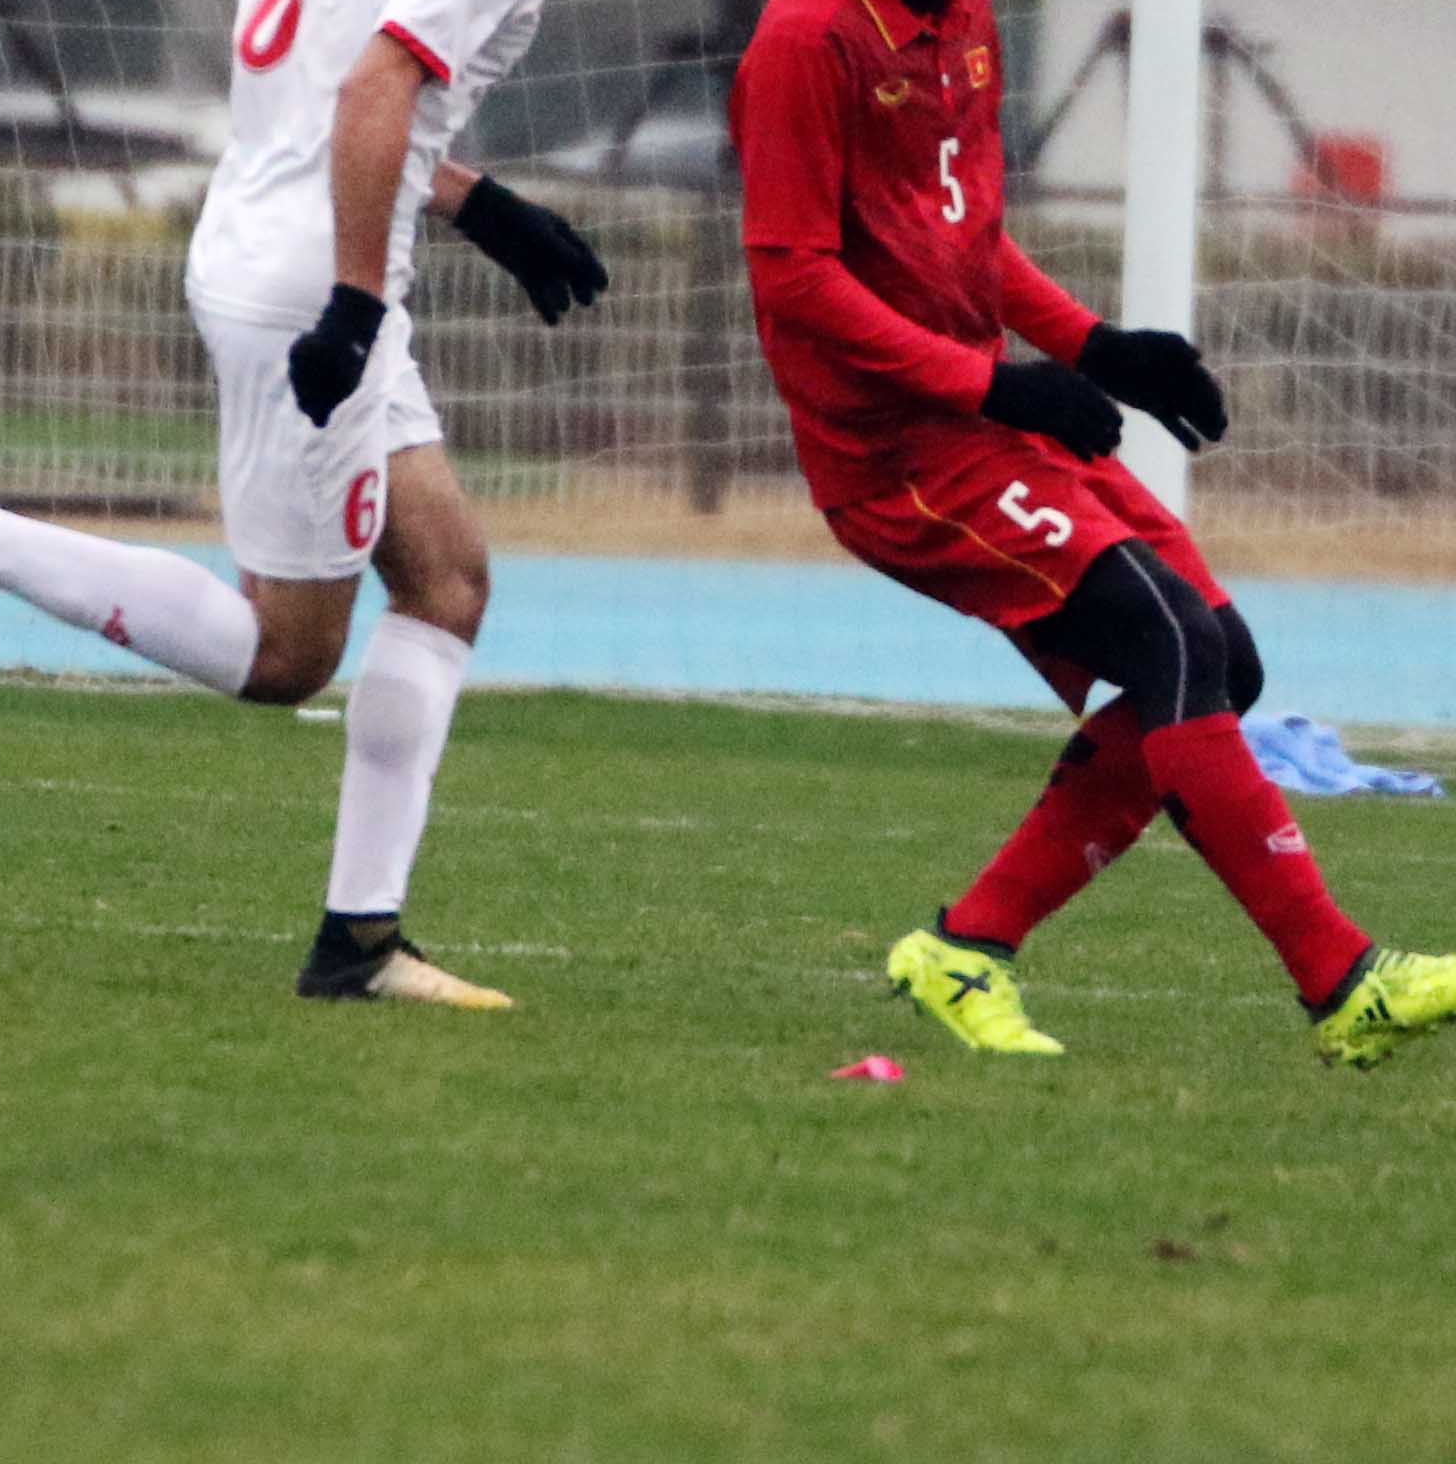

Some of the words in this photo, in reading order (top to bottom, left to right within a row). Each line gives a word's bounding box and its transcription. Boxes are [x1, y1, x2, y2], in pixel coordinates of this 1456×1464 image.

[939, 137, 966, 224] 5
[344, 468, 379, 550] 6
[996, 480, 1074, 548] 5
